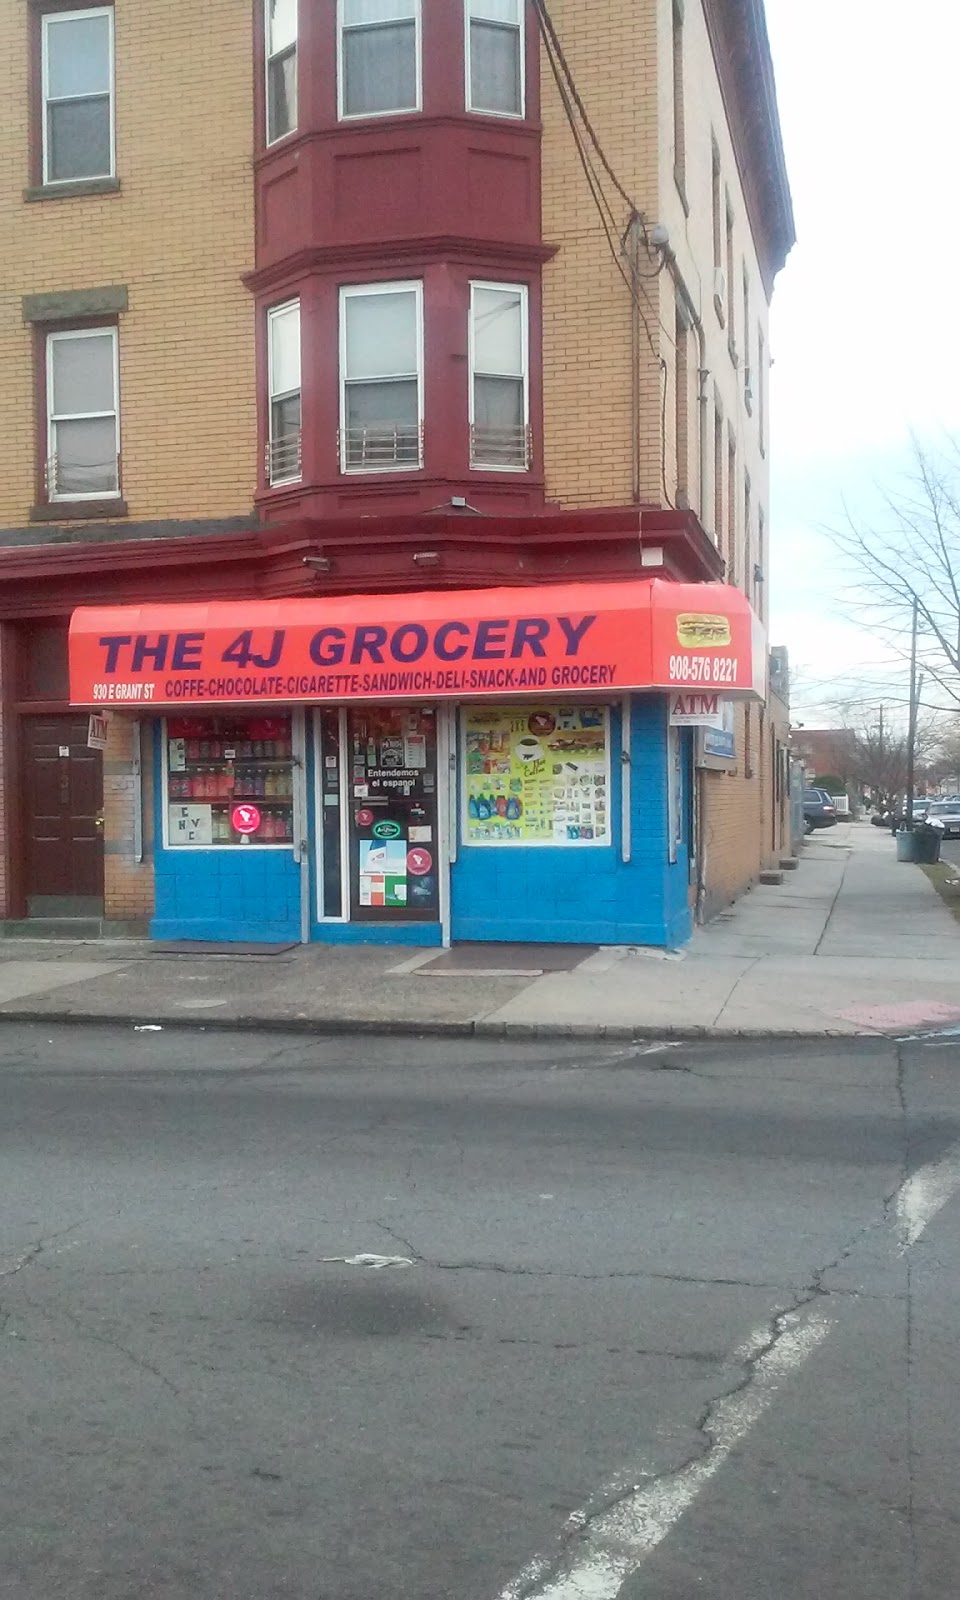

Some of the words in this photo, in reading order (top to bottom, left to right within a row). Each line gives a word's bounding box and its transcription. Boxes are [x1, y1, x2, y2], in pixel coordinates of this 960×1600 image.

[99, 633, 205, 673] THE
[221, 630, 286, 669] 4J
[309, 615, 596, 667] GROCERY
[551, 664, 617, 685] GROCERY
[669, 655, 711, 681] 908-576
[713, 657, 738, 682] 8221
[93, 683, 107, 700] 930
[108, 683, 114, 699] E
[116, 683, 143, 699] GRANT
[144, 683, 155, 699] ST
[672, 694, 720, 715] ATM
[367, 769, 419, 778] Entendemos
[372, 779, 380, 788] el
